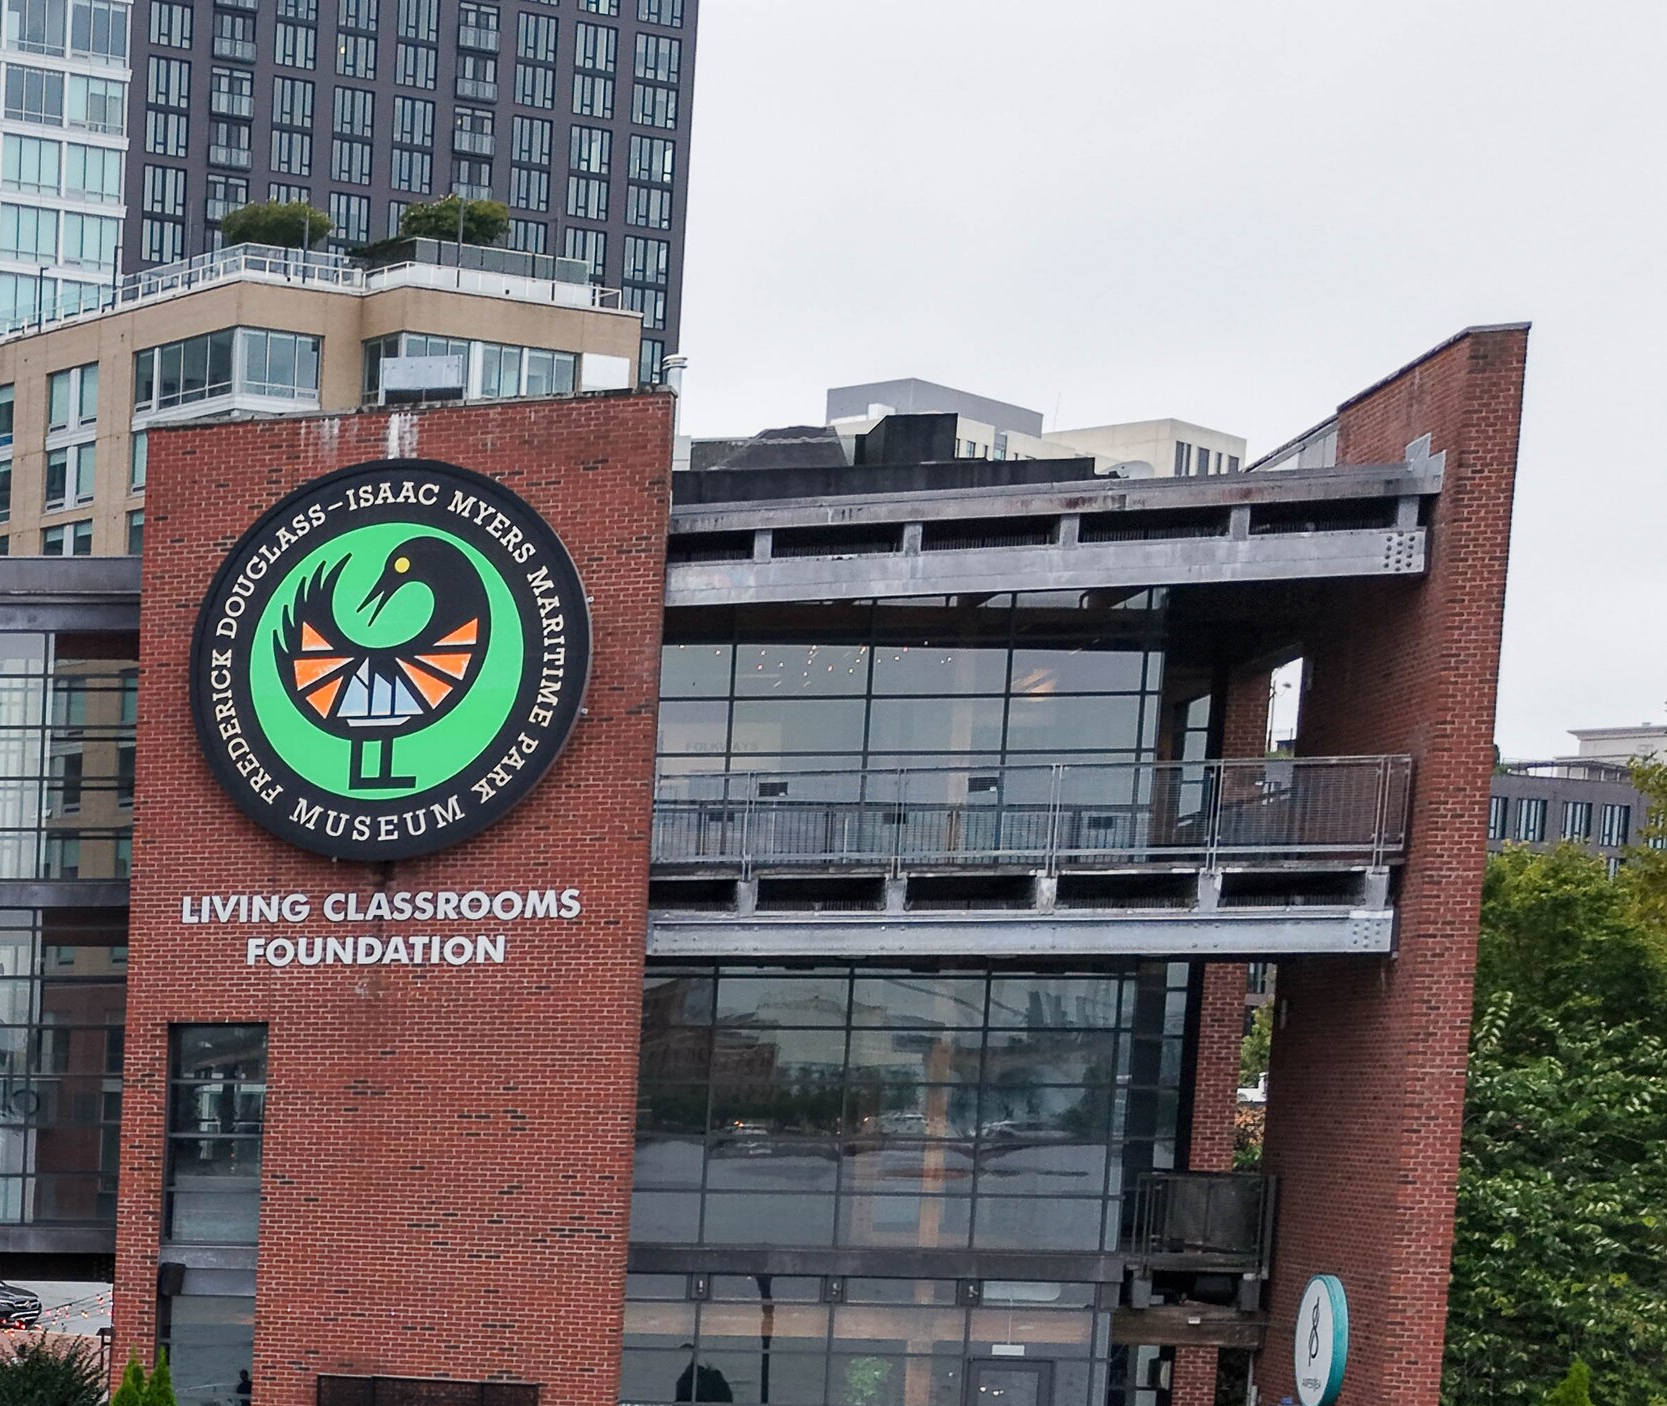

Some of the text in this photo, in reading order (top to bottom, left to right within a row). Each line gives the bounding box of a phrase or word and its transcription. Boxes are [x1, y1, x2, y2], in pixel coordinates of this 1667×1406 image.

[447, 490, 536, 563] MYERS
[527, 565, 566, 728] MARITIME
[211, 649, 284, 805] FREDERICK
[471, 732, 539, 804] PARK
[289, 794, 466, 841] MUSEUM
[181, 889, 581, 924] LIVING CLASSROOMS
[246, 934, 506, 967] FOUNDATION
